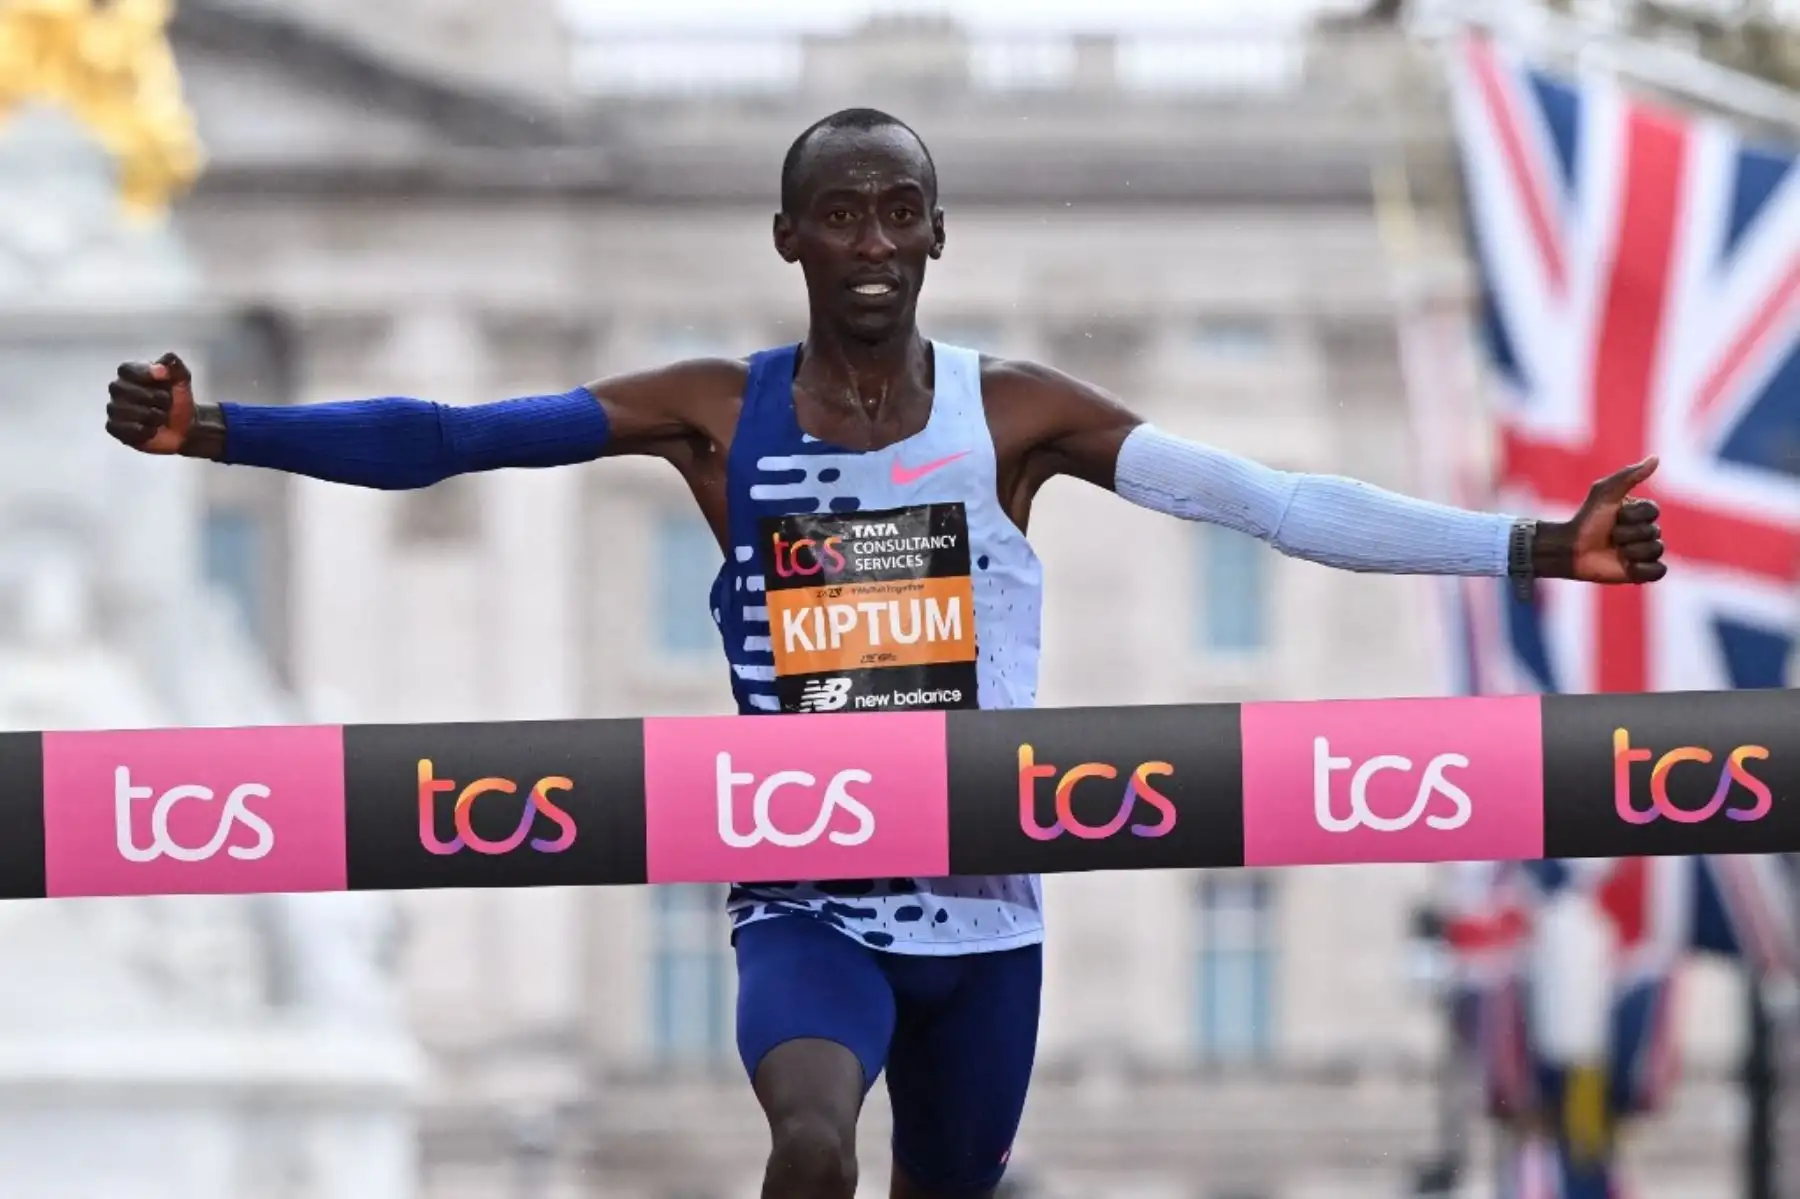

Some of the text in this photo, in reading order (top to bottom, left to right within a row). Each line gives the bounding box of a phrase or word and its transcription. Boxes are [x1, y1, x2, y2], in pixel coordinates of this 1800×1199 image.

[773, 532, 846, 577] tcs
[852, 523, 899, 538] TATA
[853, 535, 956, 554] CONSULTANCY
[855, 554, 924, 571] SERVICES
[782, 596, 963, 653] KIPTUM
[855, 688, 962, 708] new balance
[115, 765, 275, 862] tcs
[418, 758, 578, 855] tcs
[716, 751, 875, 848] tcs
[1018, 743, 1177, 840] tcs
[1313, 735, 1472, 832] tcs
[1614, 727, 1773, 824] tcs
